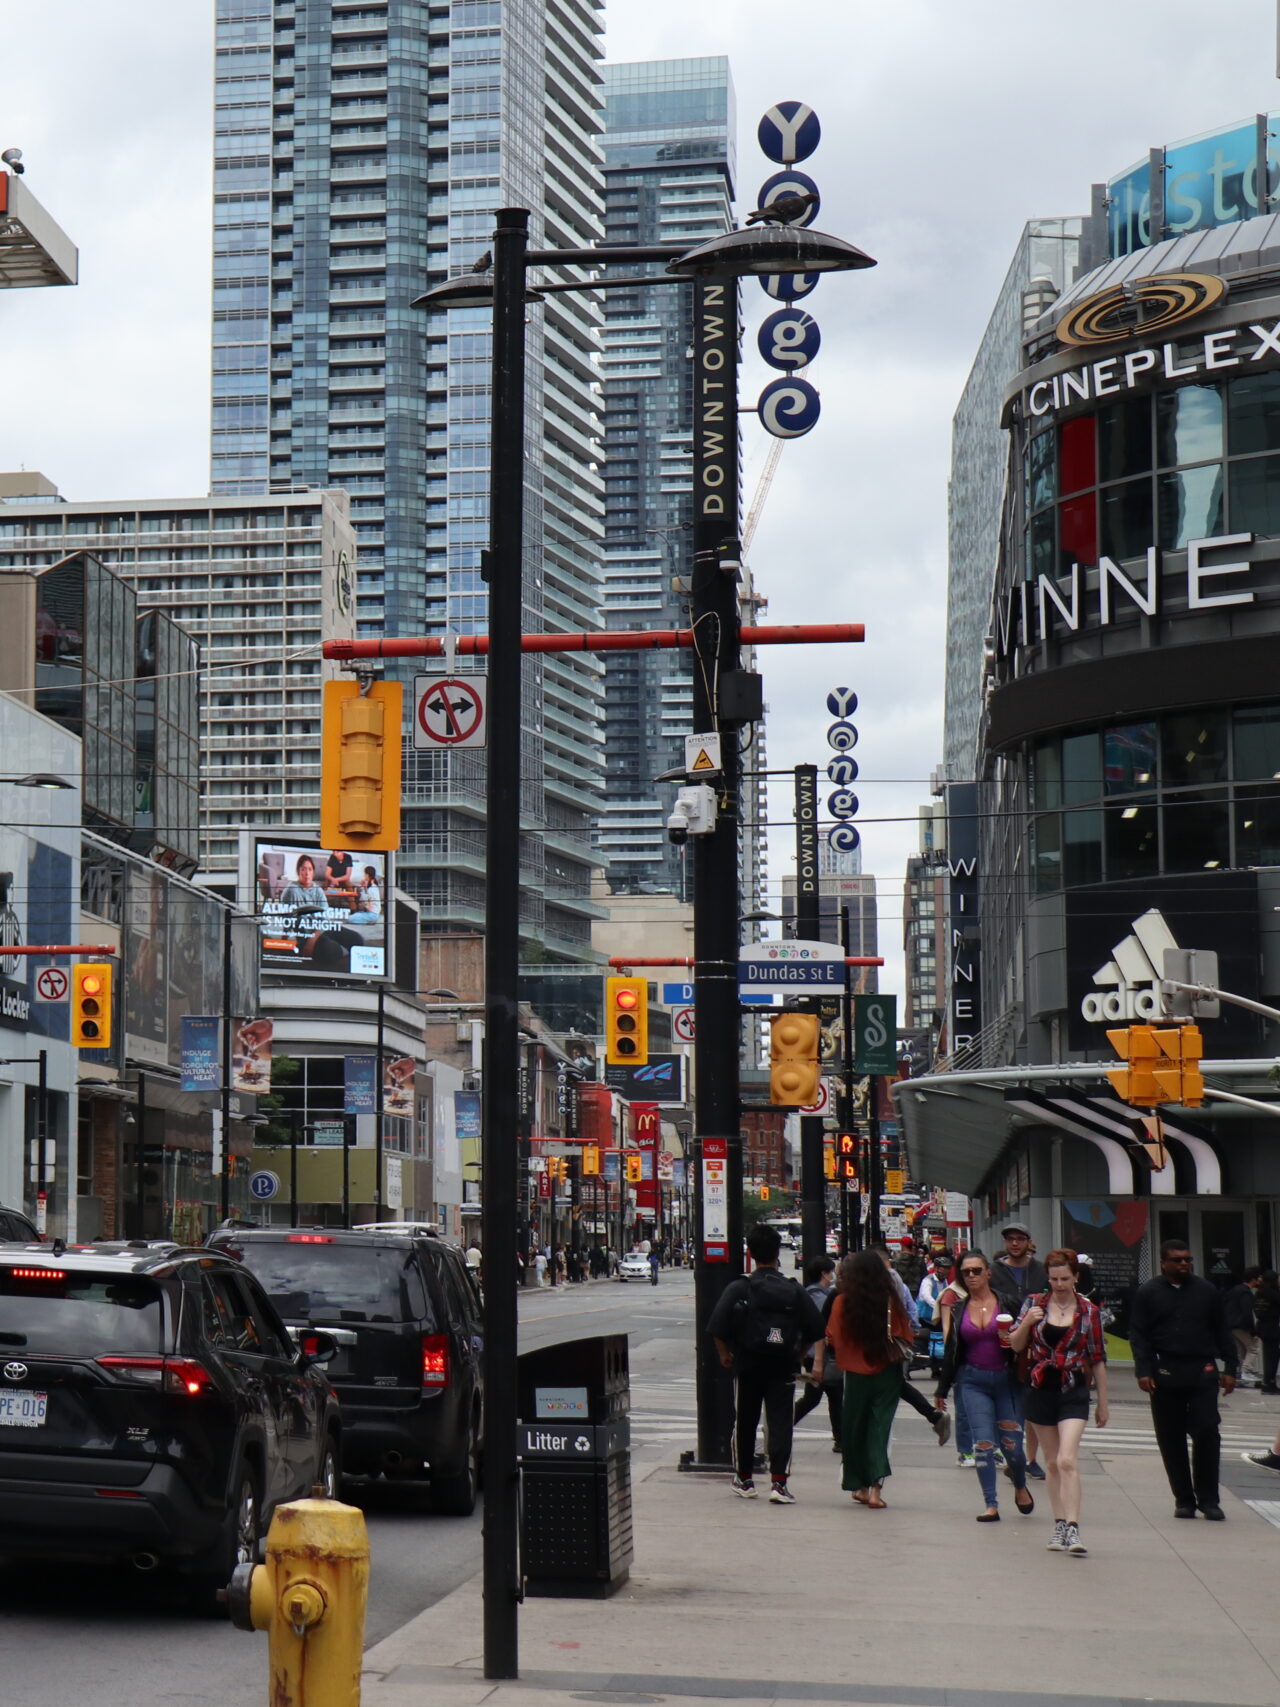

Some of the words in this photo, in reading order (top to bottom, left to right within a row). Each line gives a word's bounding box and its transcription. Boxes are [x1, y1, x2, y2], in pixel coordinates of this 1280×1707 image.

[1028, 323, 1280, 416] CINEPLEX
[703, 284, 724, 515] DOWNTOWN
[688, 736, 717, 744] ATTENTION
[829, 688, 858, 851] Yonge
[802, 774, 814, 892] DOWNTOWN
[275, 917, 297, 928] NOT
[299, 919, 343, 932] ALRIGHT
[748, 965, 806, 980] Dundas
[811, 967, 822, 980] St
[827, 965, 834, 980] E
[3, 987, 29, 1020] Locker
[22, 1399, 46, 1417] 016
[527, 1431, 568, 1450] Litter
